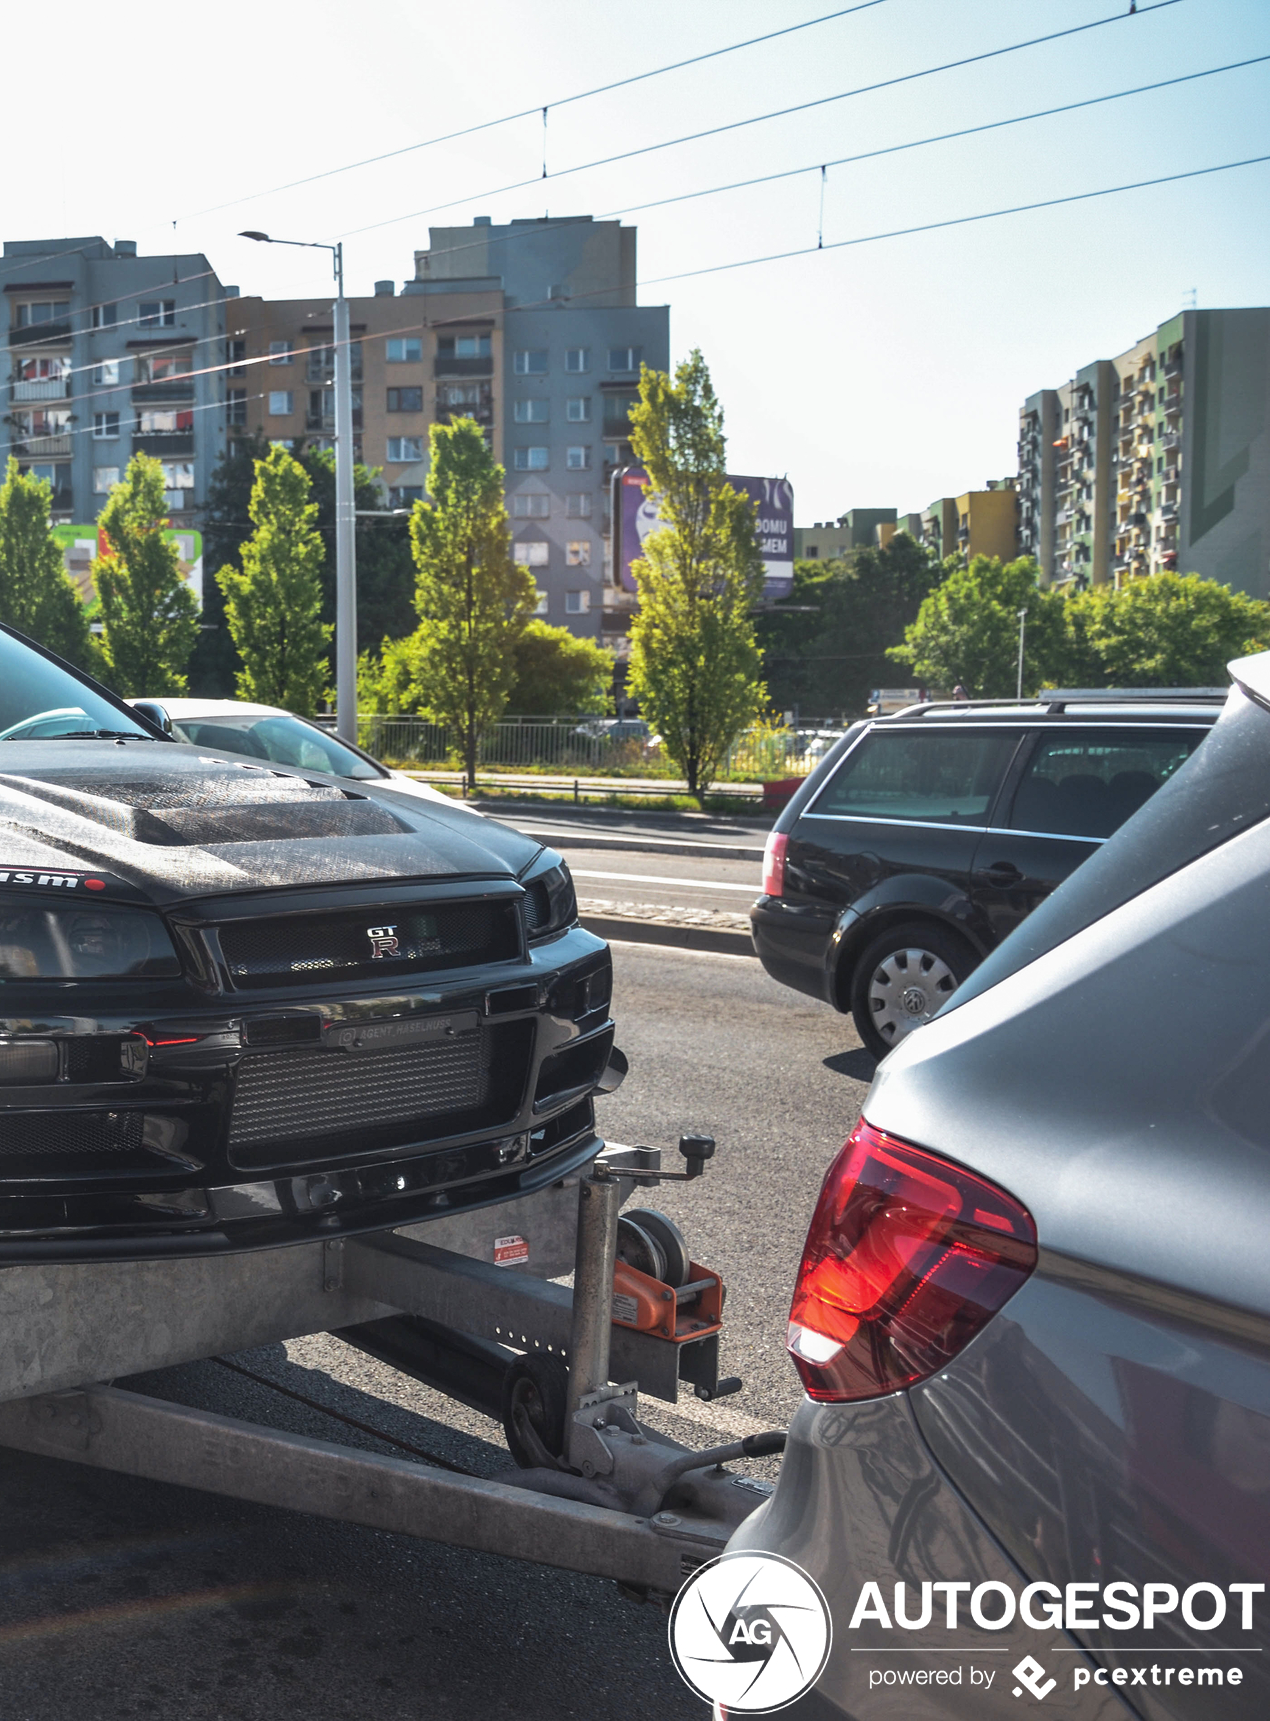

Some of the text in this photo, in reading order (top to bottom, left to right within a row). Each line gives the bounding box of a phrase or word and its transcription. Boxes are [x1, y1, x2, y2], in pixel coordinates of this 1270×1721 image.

[755, 518, 787, 534] DOMU
[367, 925, 397, 937] GT
[360, 1018, 451, 1040] AGENT_HASELNUSS
